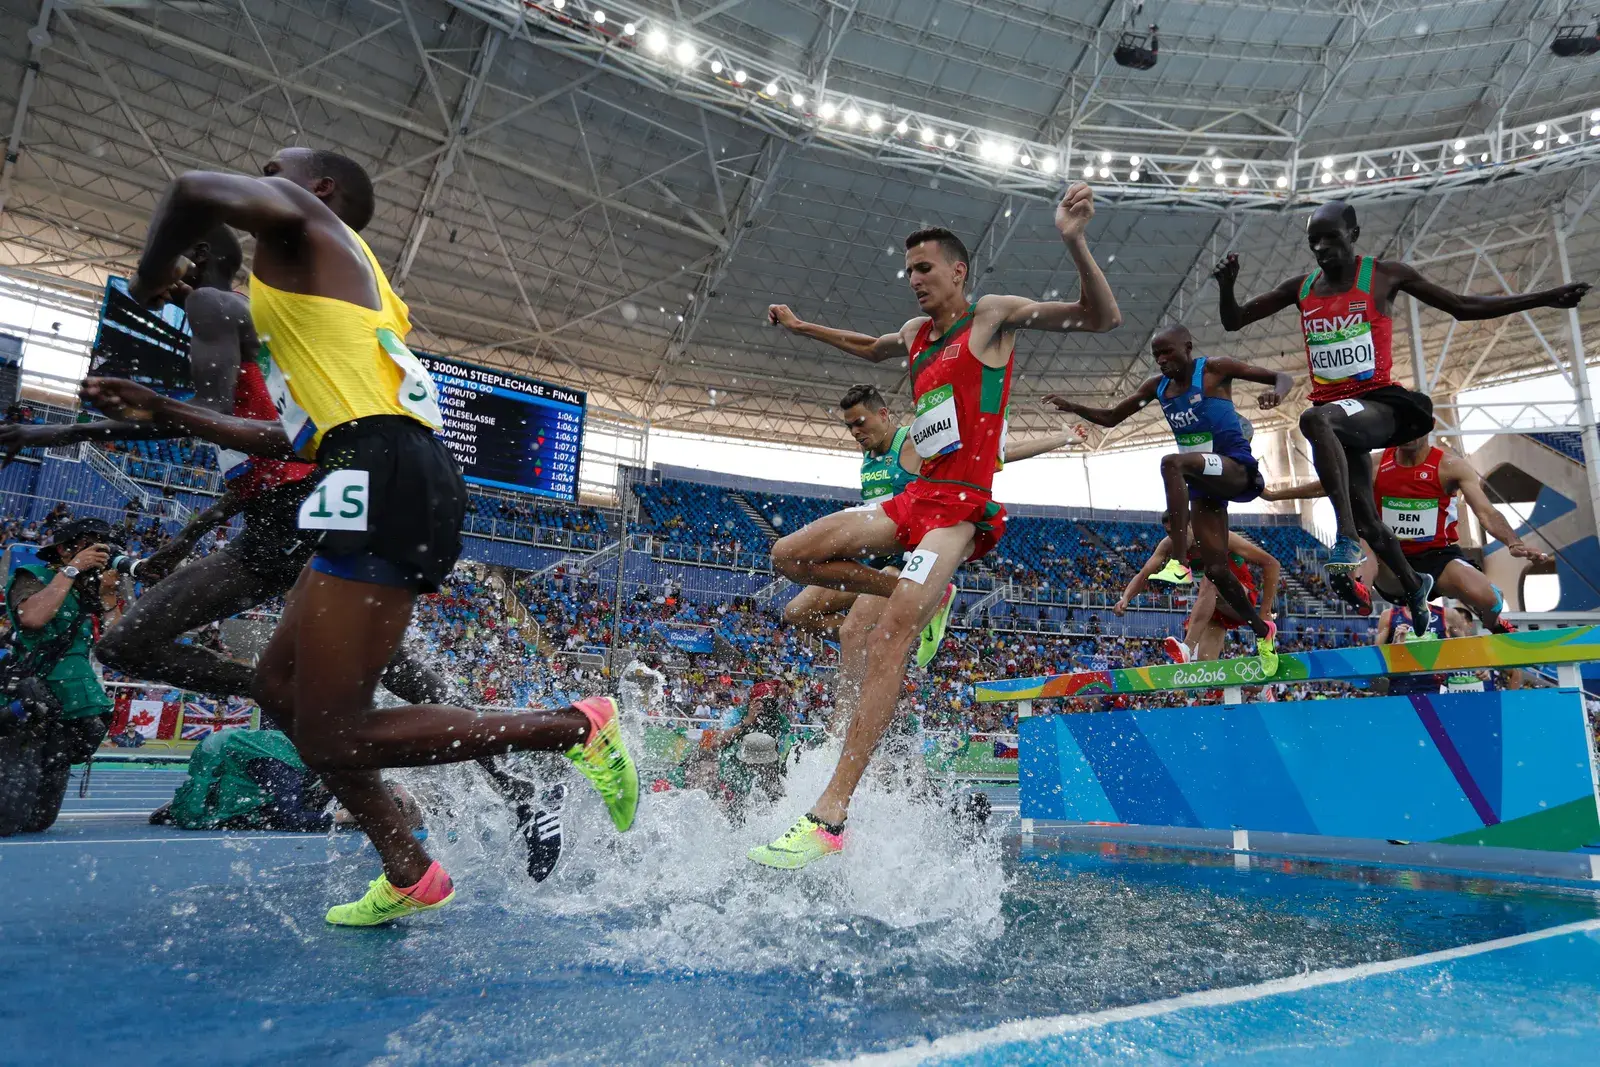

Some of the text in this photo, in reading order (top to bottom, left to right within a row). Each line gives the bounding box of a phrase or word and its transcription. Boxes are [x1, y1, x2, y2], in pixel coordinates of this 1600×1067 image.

[1304, 314, 1363, 335] KENYA
[1311, 344, 1372, 369] KEMBOI
[419, 358, 431, 370] 'S
[433, 361, 468, 378] 3000M
[470, 368, 544, 396] STEEPLECHASE
[552, 390, 580, 404] FINAL
[444, 376, 465, 388] LAPS
[466, 382, 478, 390] TO
[479, 384, 493, 394] GO
[442, 385, 579, 423] KIPRUTO 1:06.4
[439, 395, 578, 433] JAGER 1:06.6
[1166, 408, 1199, 429] USA
[439, 407, 577, 442] HAILESELASSIE 1:06.9
[442, 419, 576, 453] MEKHISSI 1:07.0
[553, 452, 575, 463] 1:07.6
[552, 462, 575, 473] 1:07.9
[860, 469, 891, 483] BRASIL
[551, 472, 574, 483] 1:07.9
[550, 482, 573, 493] 1:08.2
[309, 485, 365, 519] 15
[1398, 513, 1420, 522] BEN
[1392, 526, 1426, 535] YAHIA
[907, 555, 923, 572] 8
[670, 632, 698, 641] Rio2016
[1173, 666, 1227, 685] Rio2016
